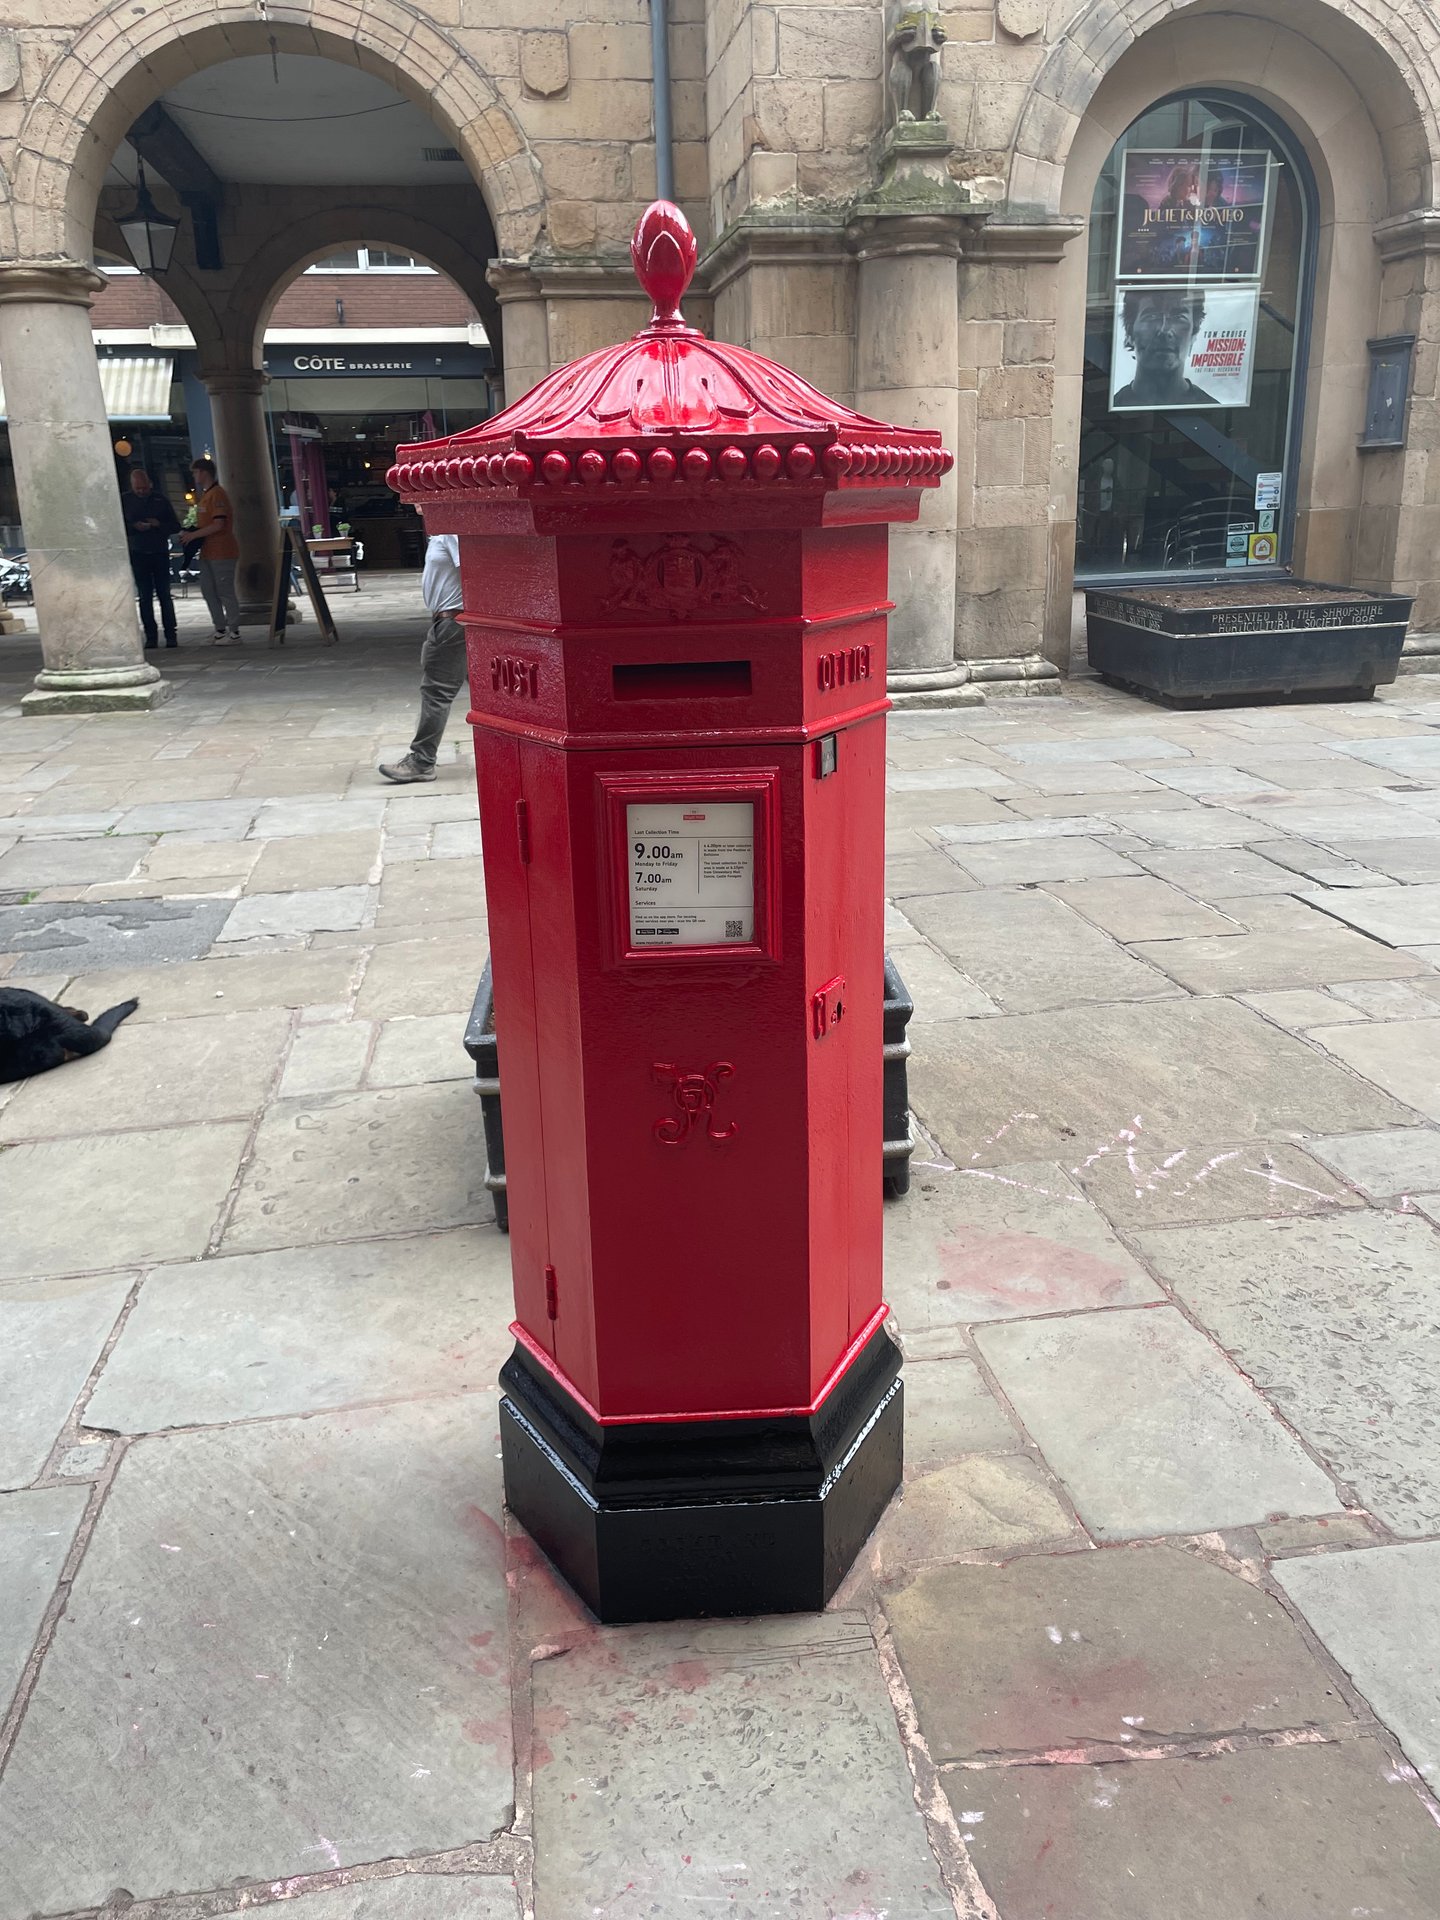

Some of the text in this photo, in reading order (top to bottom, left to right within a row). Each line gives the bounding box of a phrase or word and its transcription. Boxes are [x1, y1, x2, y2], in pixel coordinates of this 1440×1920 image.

[1221, 330, 1247, 338] CRUISE
[1206, 338, 1247, 352] MISSION:
[294, 355, 346, 370] CÔTE
[1191, 353, 1244, 367] IMPOSSIBLE
[1212, 605, 1384, 623] PRESENTED BY THE SHROPSHIRE
[1304, 617, 1344, 629] SOCIETY
[490, 655, 540, 698] POST
[635, 843, 683, 859] 9.00am
[635, 872, 671, 883] 7.00am
